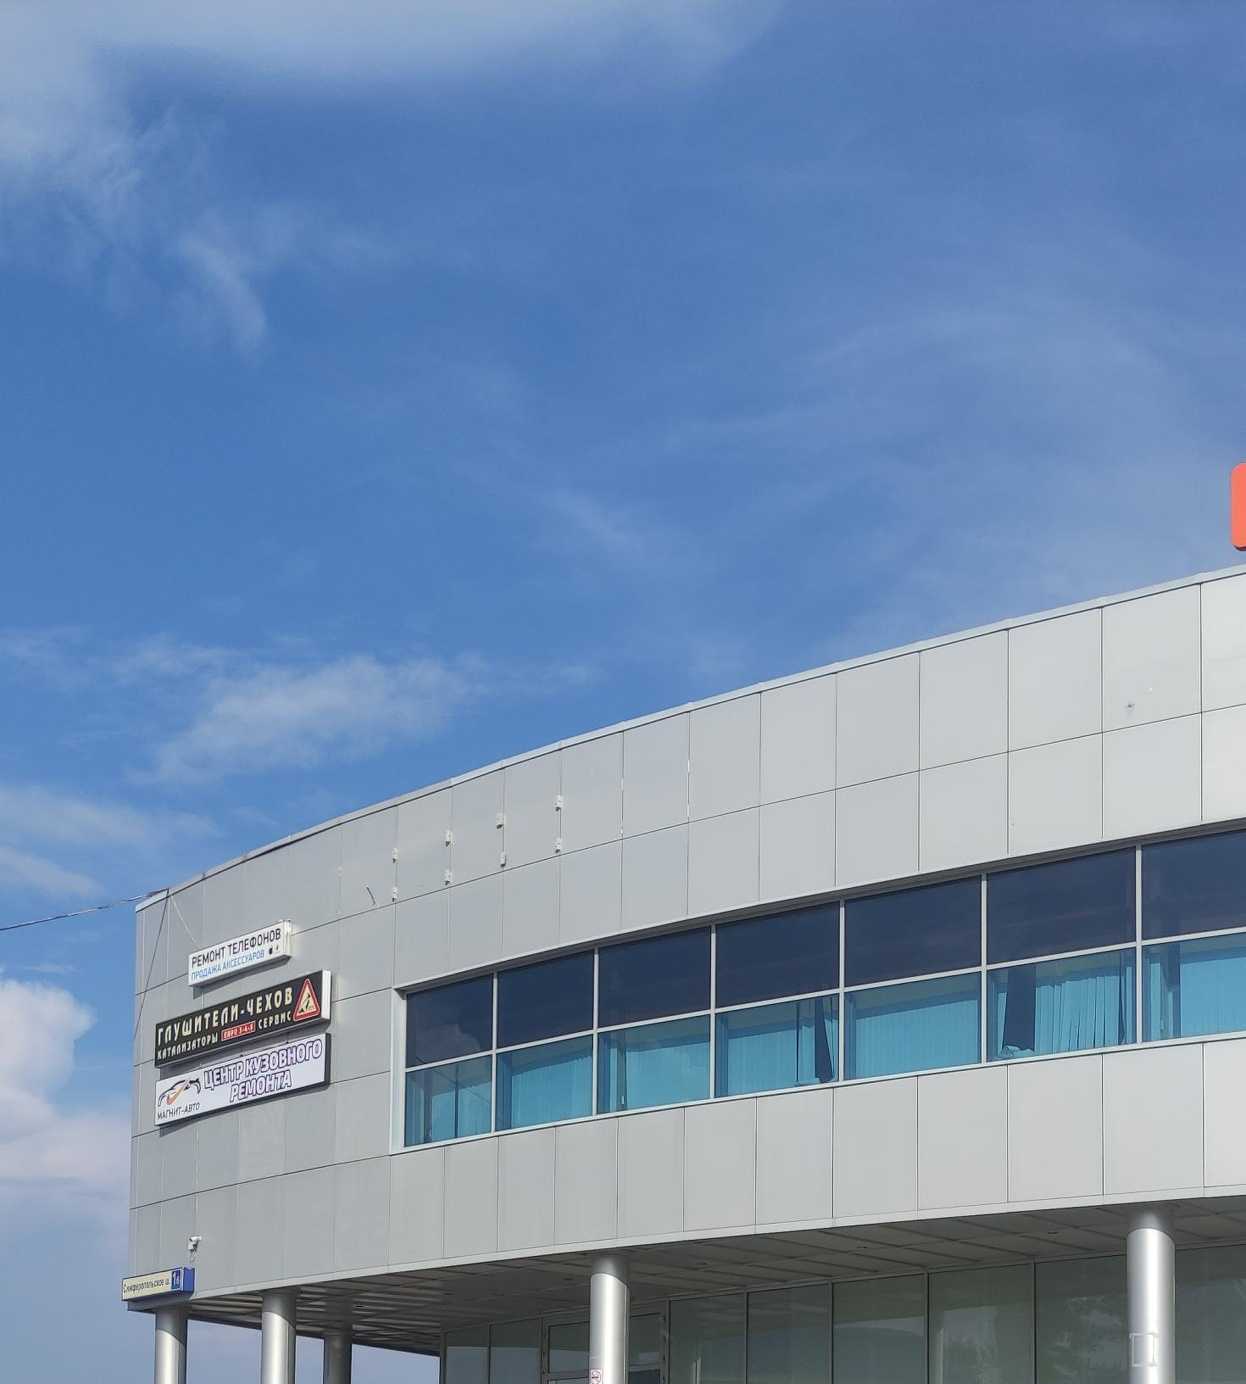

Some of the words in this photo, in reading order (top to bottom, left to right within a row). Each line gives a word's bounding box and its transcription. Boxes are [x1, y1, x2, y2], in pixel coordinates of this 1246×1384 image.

[191, 946, 225, 969] РЕМОНТ
[227, 927, 281, 955] ТЕЛЕФОНОВ
[191, 964, 221, 981] ПРОДАЖА
[223, 949, 265, 969] АКСЕССУАРОВ
[157, 1032, 218, 1060] КАТАЛИЗАТОРЫ
[258, 1010, 292, 1030] СЕРВИС
[158, 987, 293, 1047] ГЛУШИТЕЛИ-ЧЕХОВ
[203, 1059, 244, 1091] ЦЕНТР
[244, 1039, 323, 1077] КУЗОВНОГО
[229, 1069, 293, 1103] РЕМОНТА
[157, 1102, 200, 1120] МАГНИТ-АВТО
